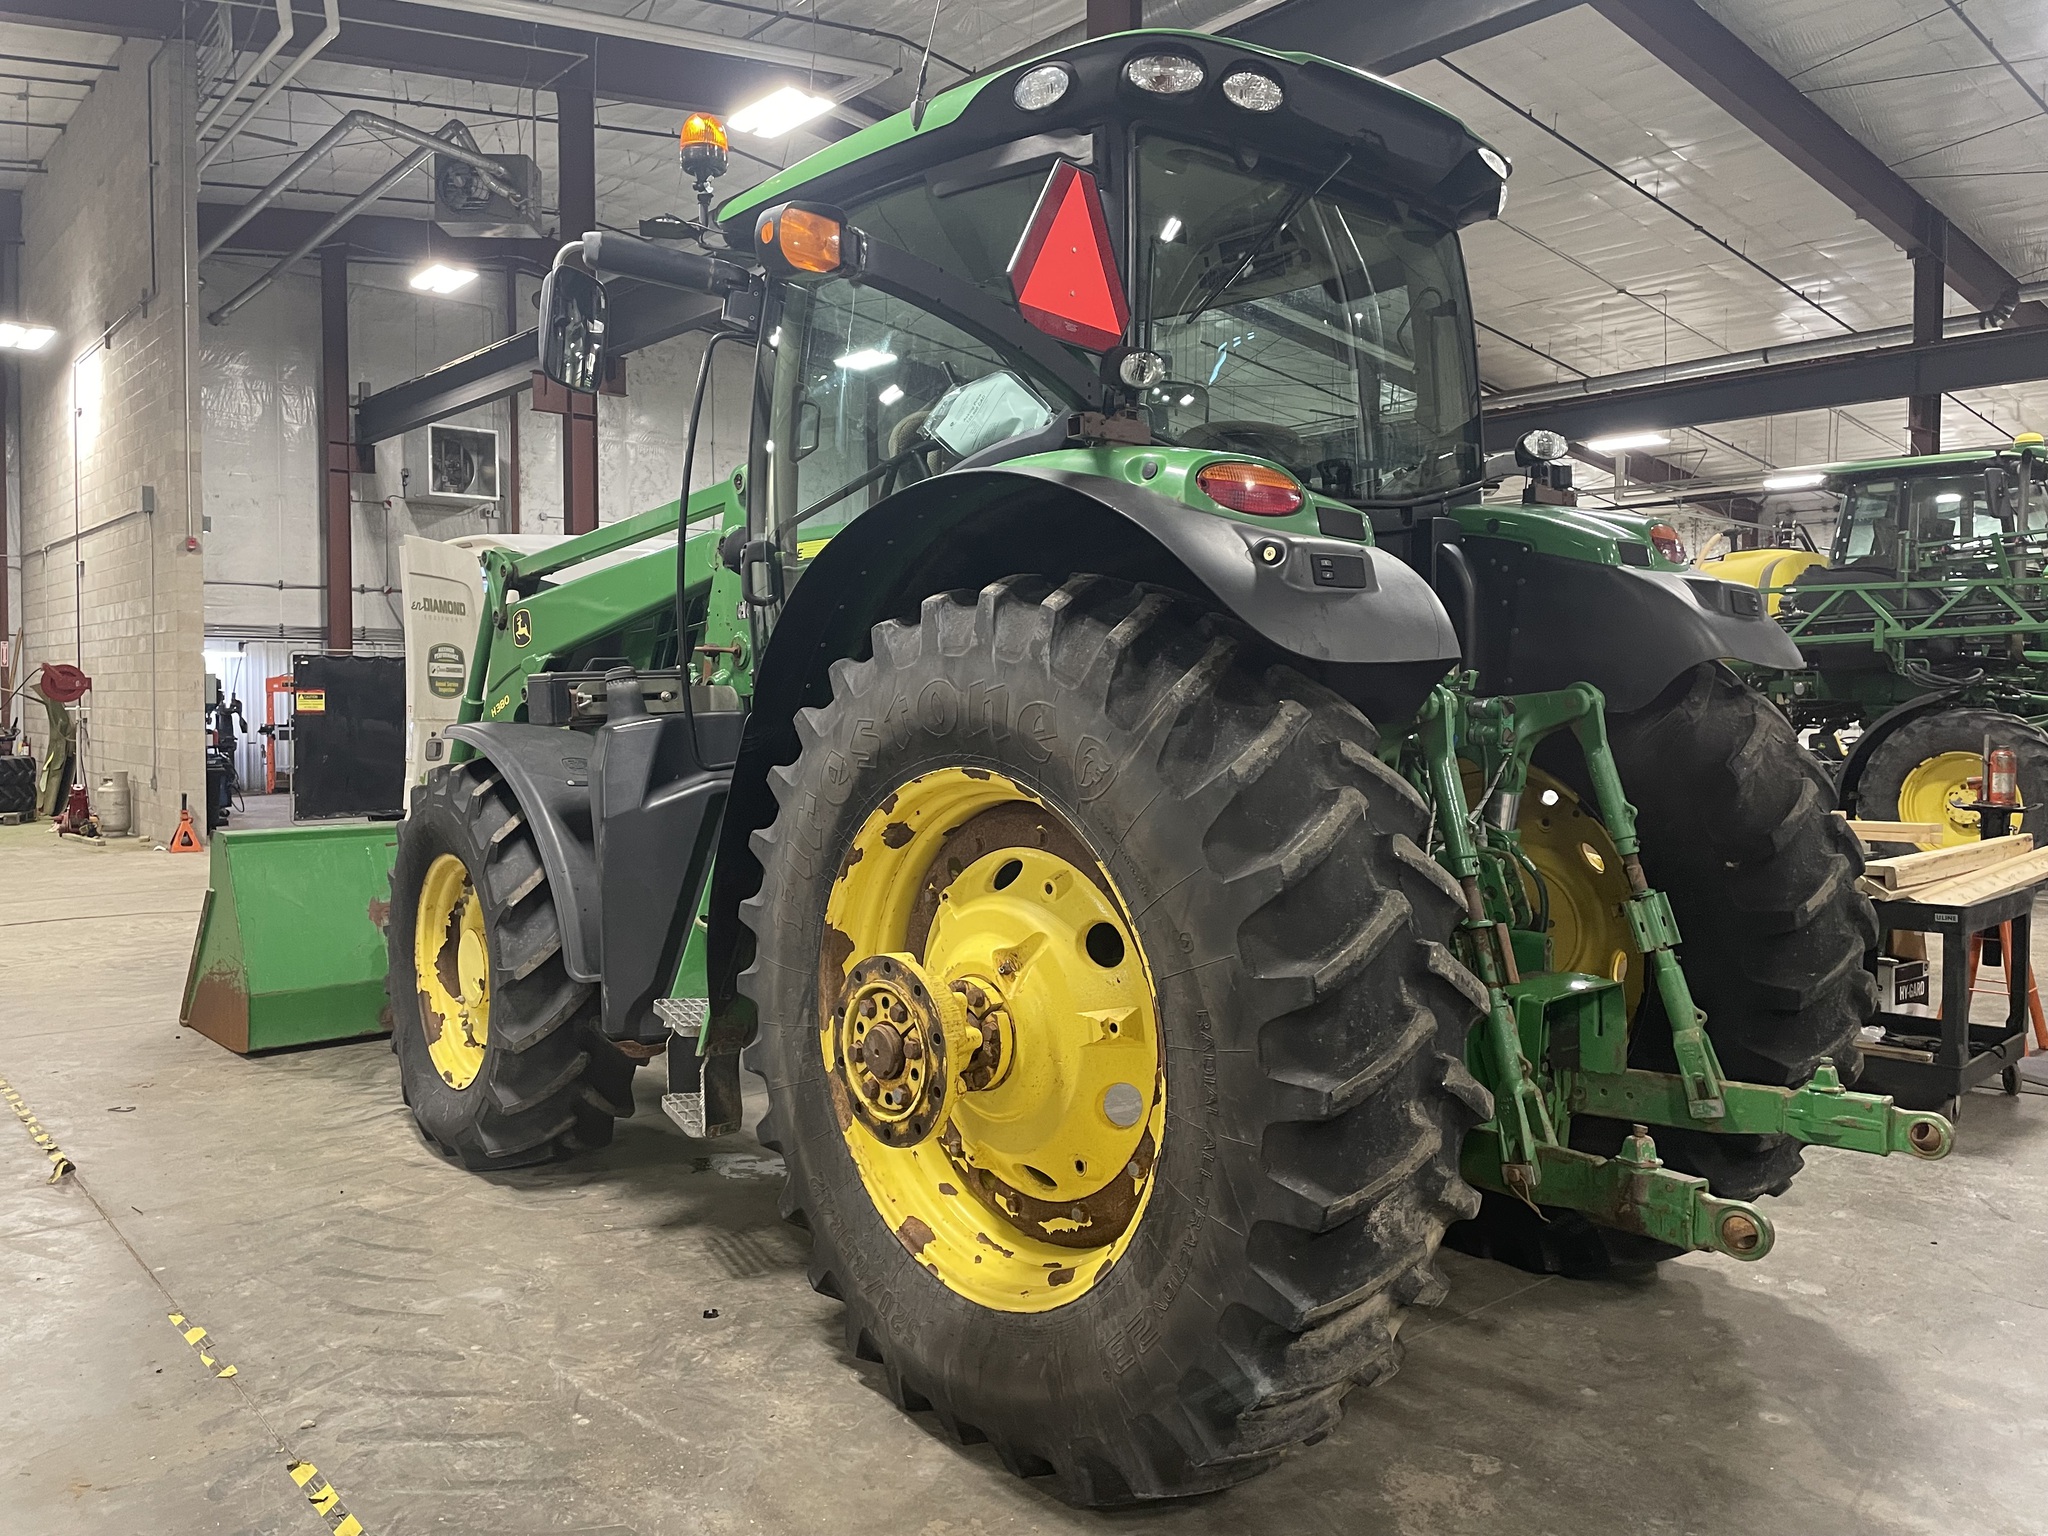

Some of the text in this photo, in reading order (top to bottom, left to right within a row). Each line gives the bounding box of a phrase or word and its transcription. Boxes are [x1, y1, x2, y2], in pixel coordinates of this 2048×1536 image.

[490, 694, 510, 718] H380
[772, 678, 1060, 931] Firestone
[1899, 981, 1925, 1001] HY-GARD
[1196, 1009, 1219, 1116] RADIAL
[1199, 1130, 1217, 1180] ALL
[1153, 1195, 1210, 1319] TRACTION
